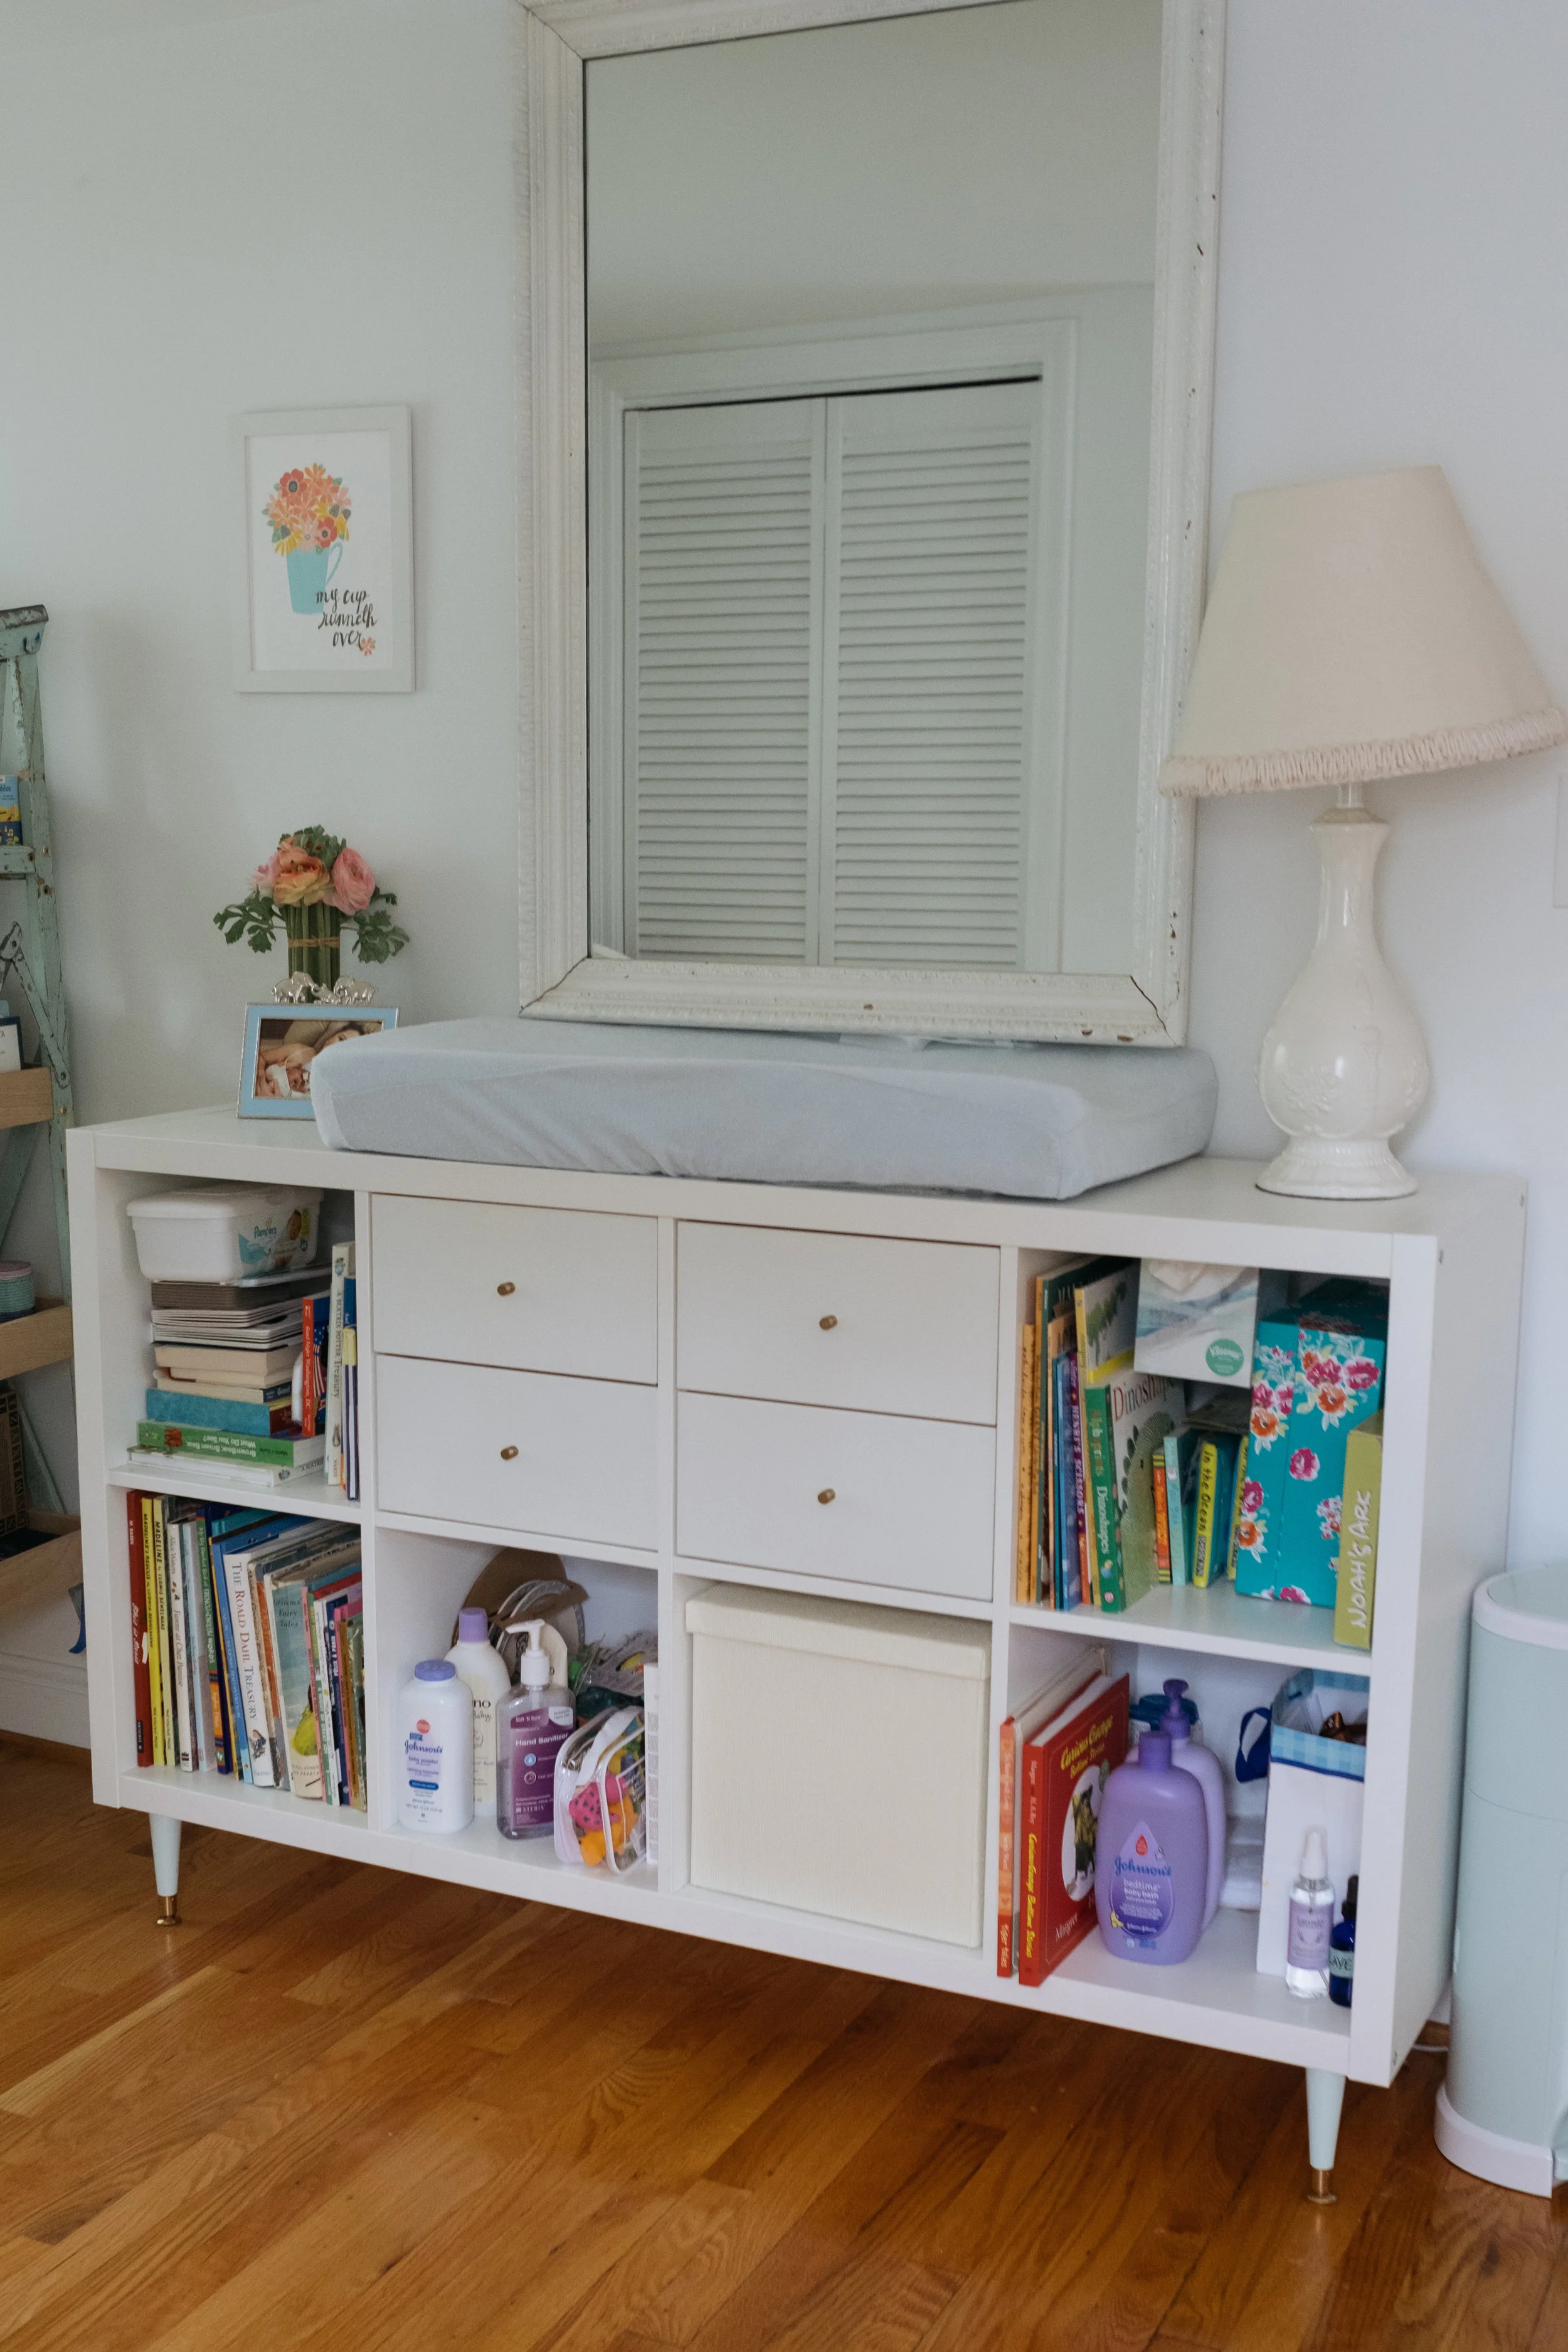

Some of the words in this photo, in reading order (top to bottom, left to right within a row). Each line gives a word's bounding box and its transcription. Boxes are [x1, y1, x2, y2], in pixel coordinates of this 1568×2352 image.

[315, 589, 339, 612] my
[342, 590, 367, 612] cup
[332, 630, 363, 649] over
[254, 1224, 277, 1239] Pampers
[1209, 1345, 1241, 1360] Kleenex
[330, 1358, 342, 1398] Treasury
[203, 1435, 218, 1444] See?
[1071, 1405, 1081, 1452] HENRI'S
[186, 1440, 200, 1450] Bear,
[201, 1443, 220, 1453] Brown
[221, 1446, 236, 1454] Bear,
[230, 1439, 239, 1447] Do
[238, 1448, 256, 1456] Brown
[241, 1439, 256, 1448] What
[1202, 1450, 1214, 1463] In
[1074, 1458, 1084, 1514] SCISSORS
[1201, 1468, 1212, 1490] the
[1093, 1485, 1113, 1554] Dinoshapes
[1198, 1493, 1211, 1532] Ocean
[1348, 1489, 1372, 1540] ARK
[231, 1562, 244, 1586] THE
[1347, 1541, 1372, 1628] NOAH'S
[234, 1589, 248, 1628] ROALD
[173, 1609, 181, 1631] Fanny
[206, 1637, 215, 1665] WORDS
[239, 1631, 253, 1663] DAHL
[243, 1665, 260, 1721] TREASURY
[405, 1739, 443, 1754] Johnson's
[516, 1737, 536, 1747] Hand
[538, 1732, 569, 1744] Sanitizer
[1061, 1736, 1089, 1771] Curious
[1089, 1714, 1114, 1746] George
[1027, 1833, 1037, 1865] Curious
[1115, 1855, 1172, 1877] Johnson's
[1025, 1864, 1036, 1893] George
[1124, 1877, 1160, 1891] bedtime
